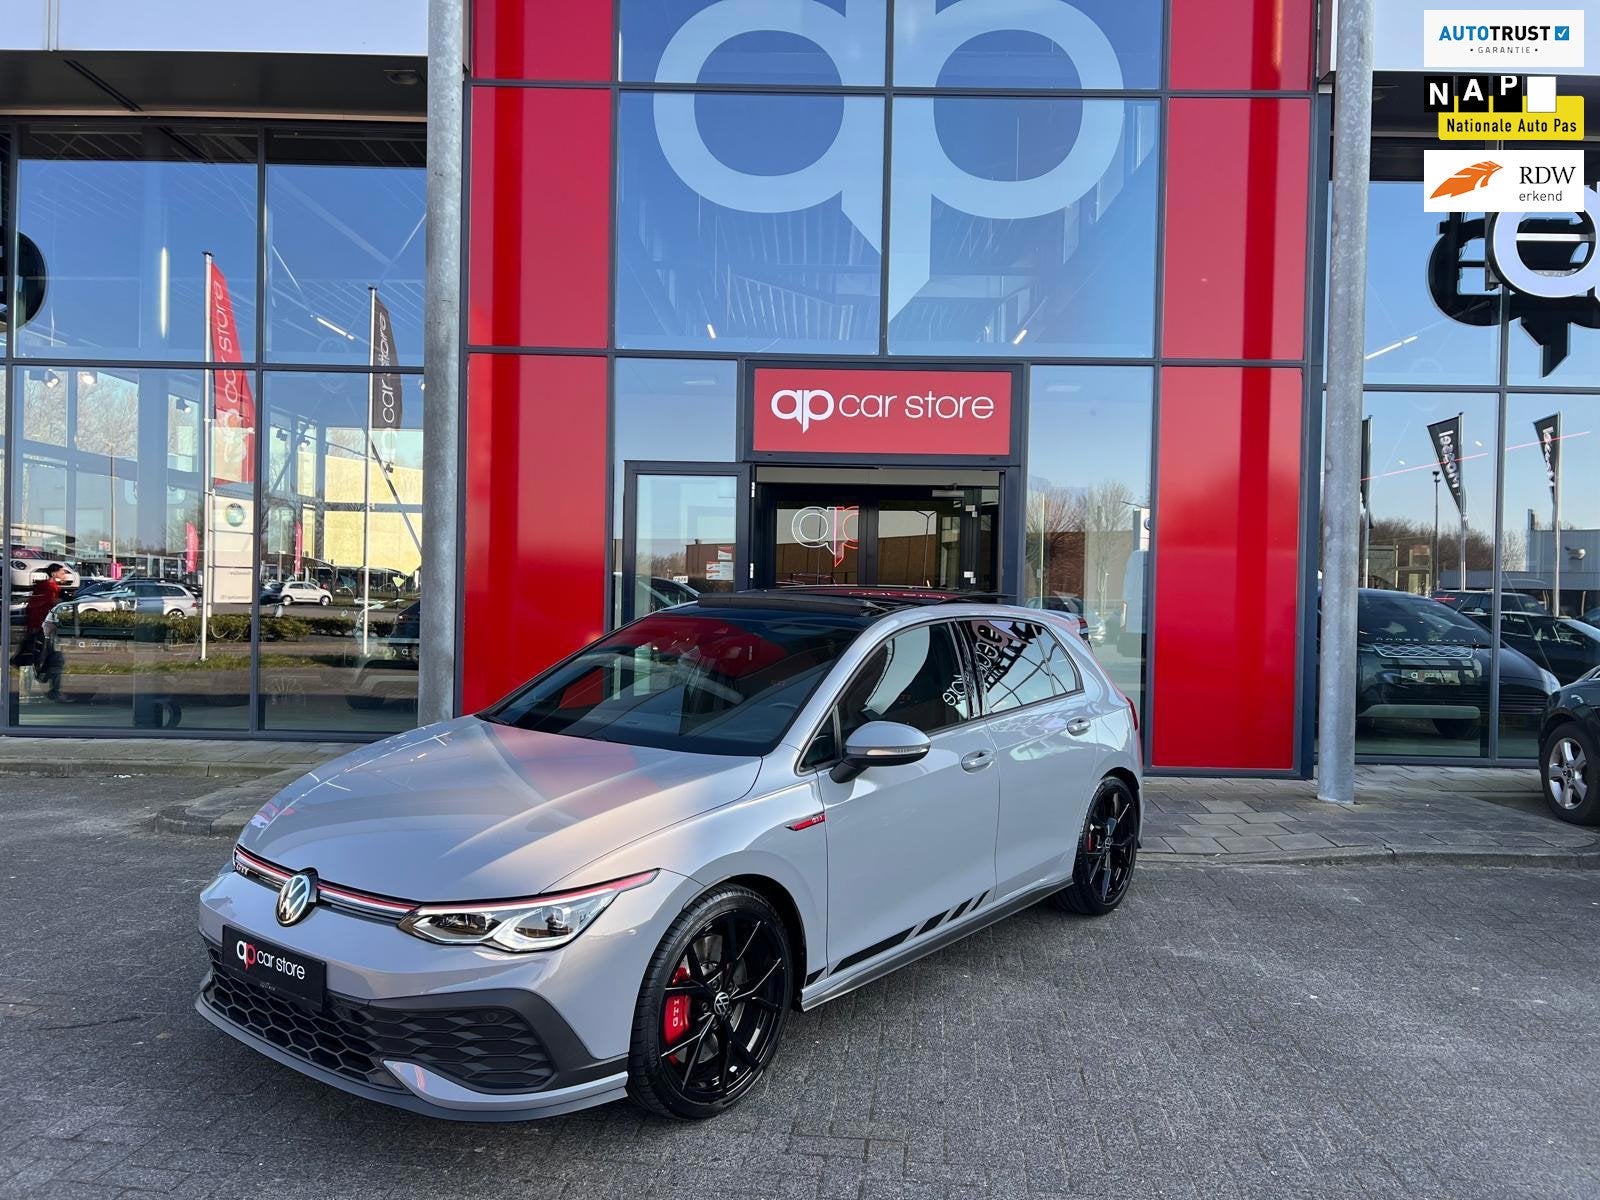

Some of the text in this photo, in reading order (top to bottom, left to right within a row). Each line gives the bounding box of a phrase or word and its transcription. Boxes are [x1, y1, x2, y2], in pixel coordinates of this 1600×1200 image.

[213, 280, 232, 354] store
[382, 378, 395, 424] car
[770, 389, 995, 434] ap car store
[236, 940, 306, 980] ap car store
[672, 999, 681, 1028] GTI
